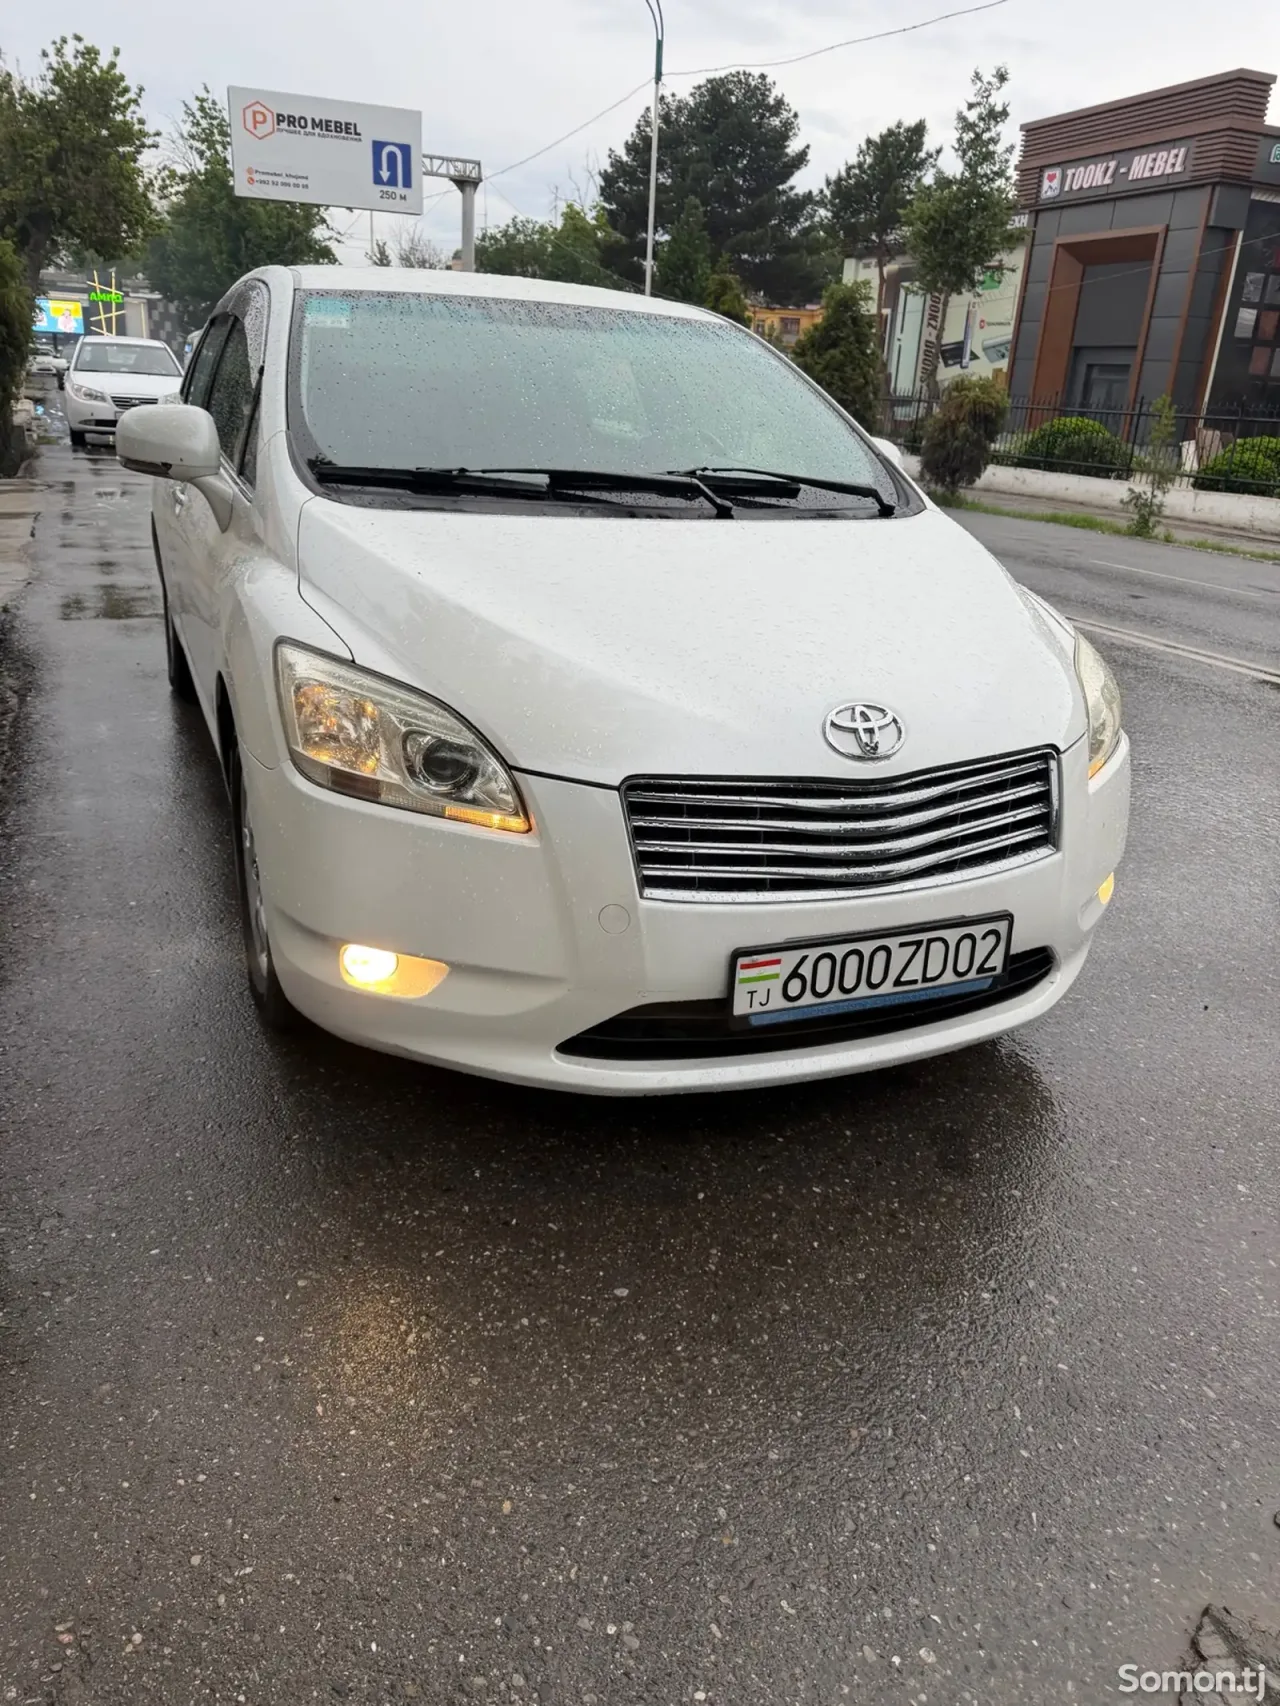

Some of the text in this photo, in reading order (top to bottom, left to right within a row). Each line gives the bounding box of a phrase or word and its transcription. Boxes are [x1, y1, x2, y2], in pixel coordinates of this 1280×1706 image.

[276, 112, 362, 137] PRO MEBEL
[1063, 160, 1118, 192] TOOKZ
[1128, 147, 1189, 181] MEBEL
[379, 189, 397, 201] 250
[926, 291, 942, 331] OOKZ
[781, 928, 1002, 1003] 6000ZD02
[747, 988, 771, 1009] TJ
